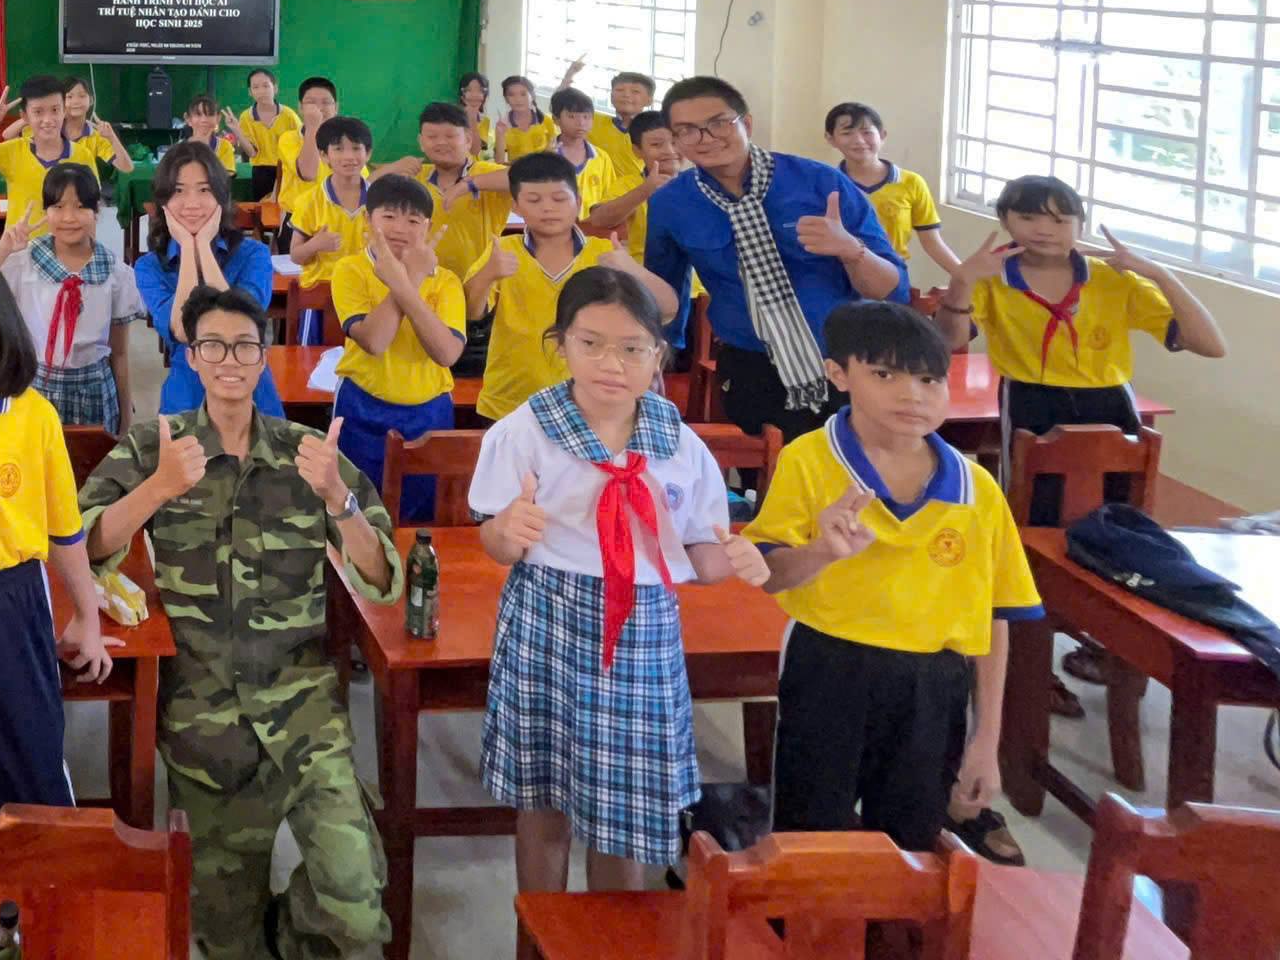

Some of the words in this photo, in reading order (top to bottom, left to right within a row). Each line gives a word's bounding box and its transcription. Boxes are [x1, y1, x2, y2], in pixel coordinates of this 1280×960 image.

[167, 8, 188, 18] TẠO
[218, 8, 241, 17] CHO
[135, 19, 157, 29] HỌC
[158, 19, 182, 28] SINH
[183, 19, 203, 28] 2025
